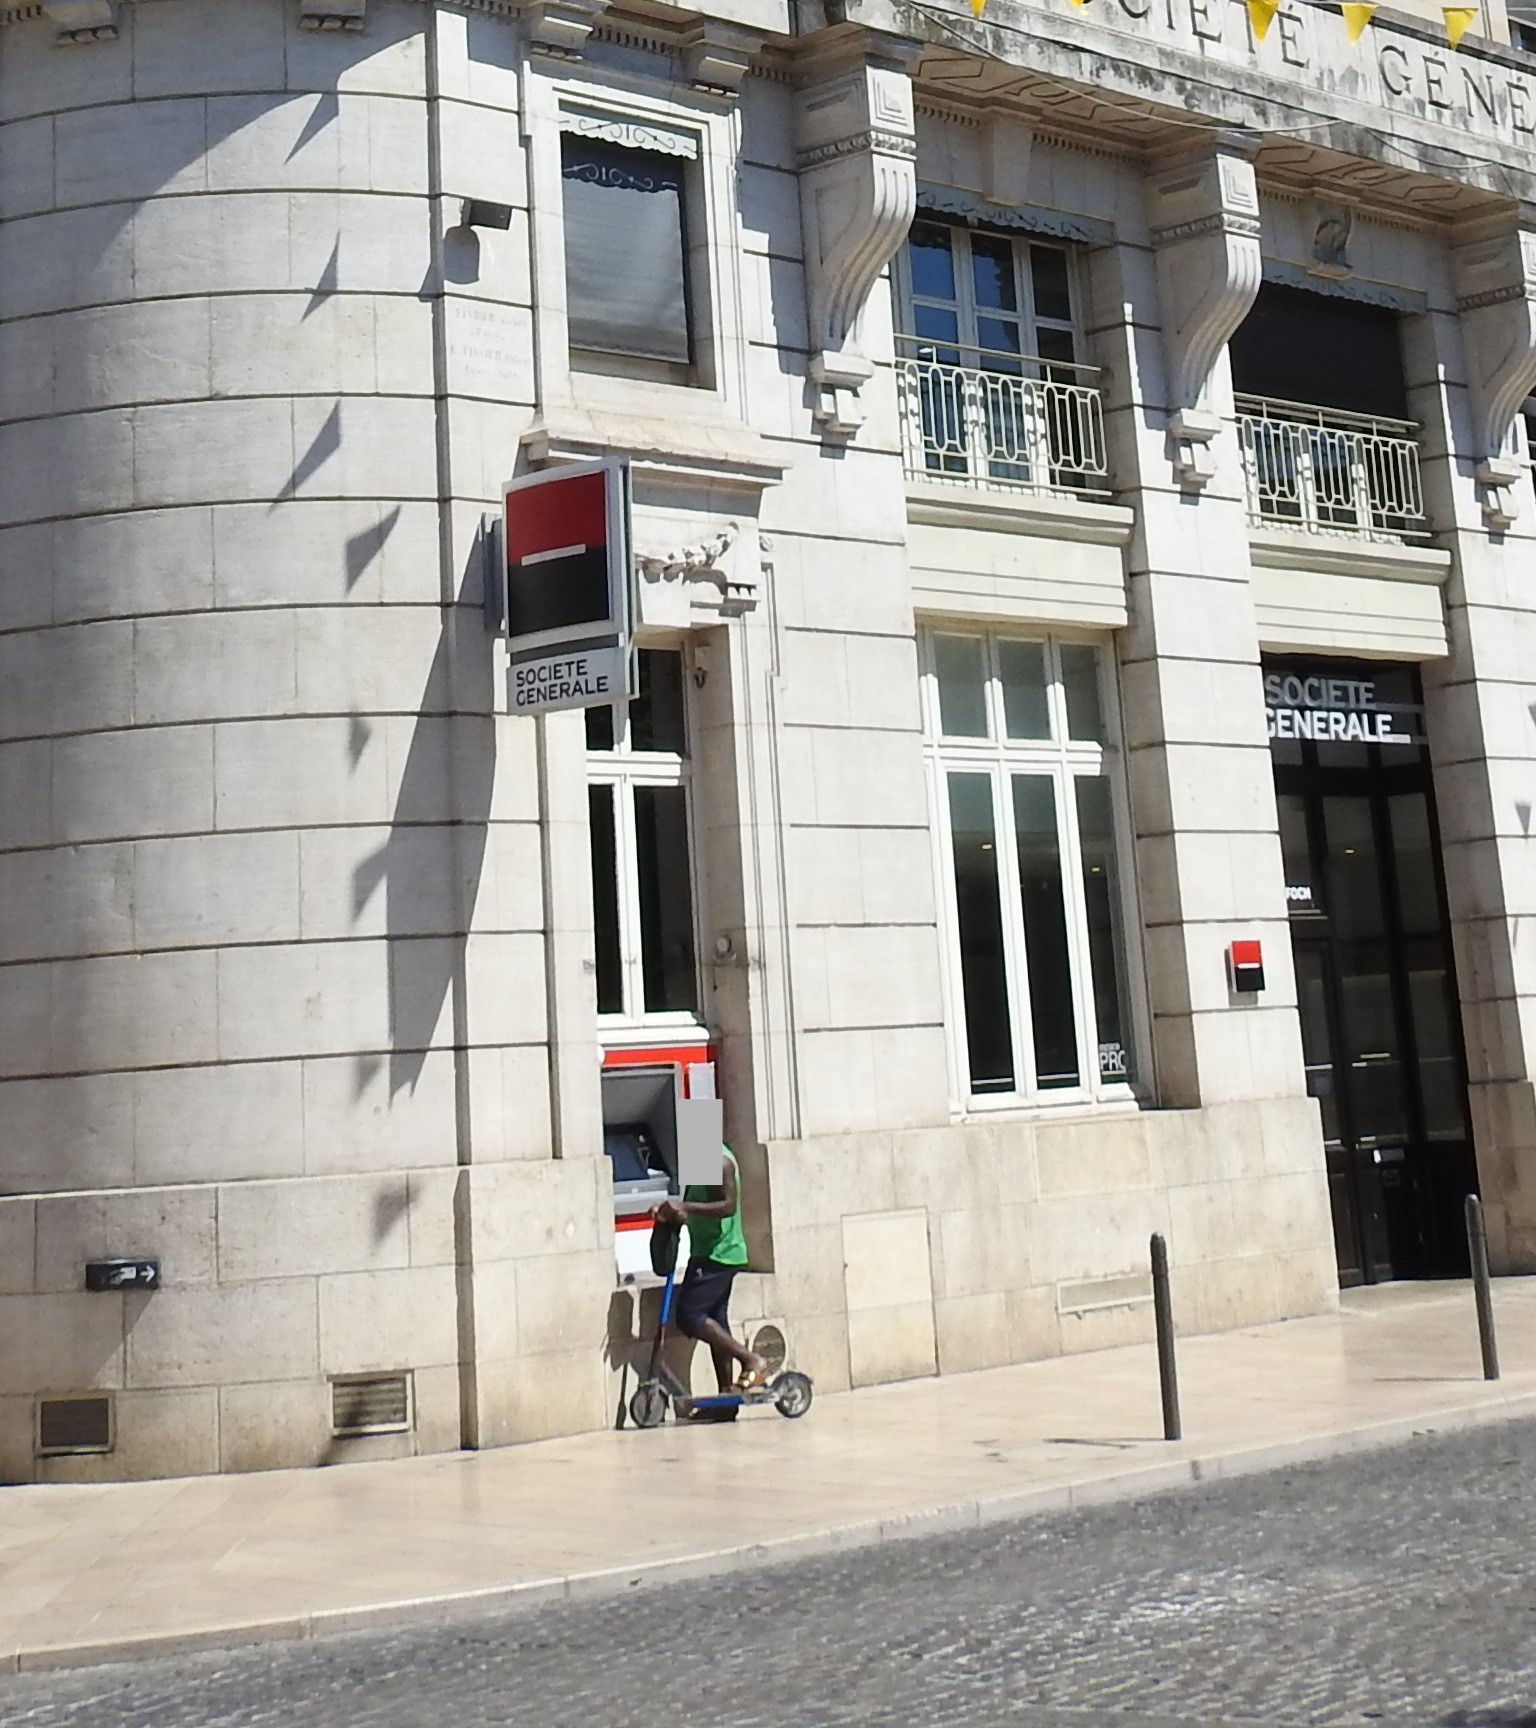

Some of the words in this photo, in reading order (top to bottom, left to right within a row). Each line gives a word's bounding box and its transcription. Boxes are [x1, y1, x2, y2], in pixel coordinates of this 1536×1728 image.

[516, 659, 588, 689] SOCIETE
[516, 675, 610, 707] GENERALE
[1265, 674, 1377, 710] SOCIETE
